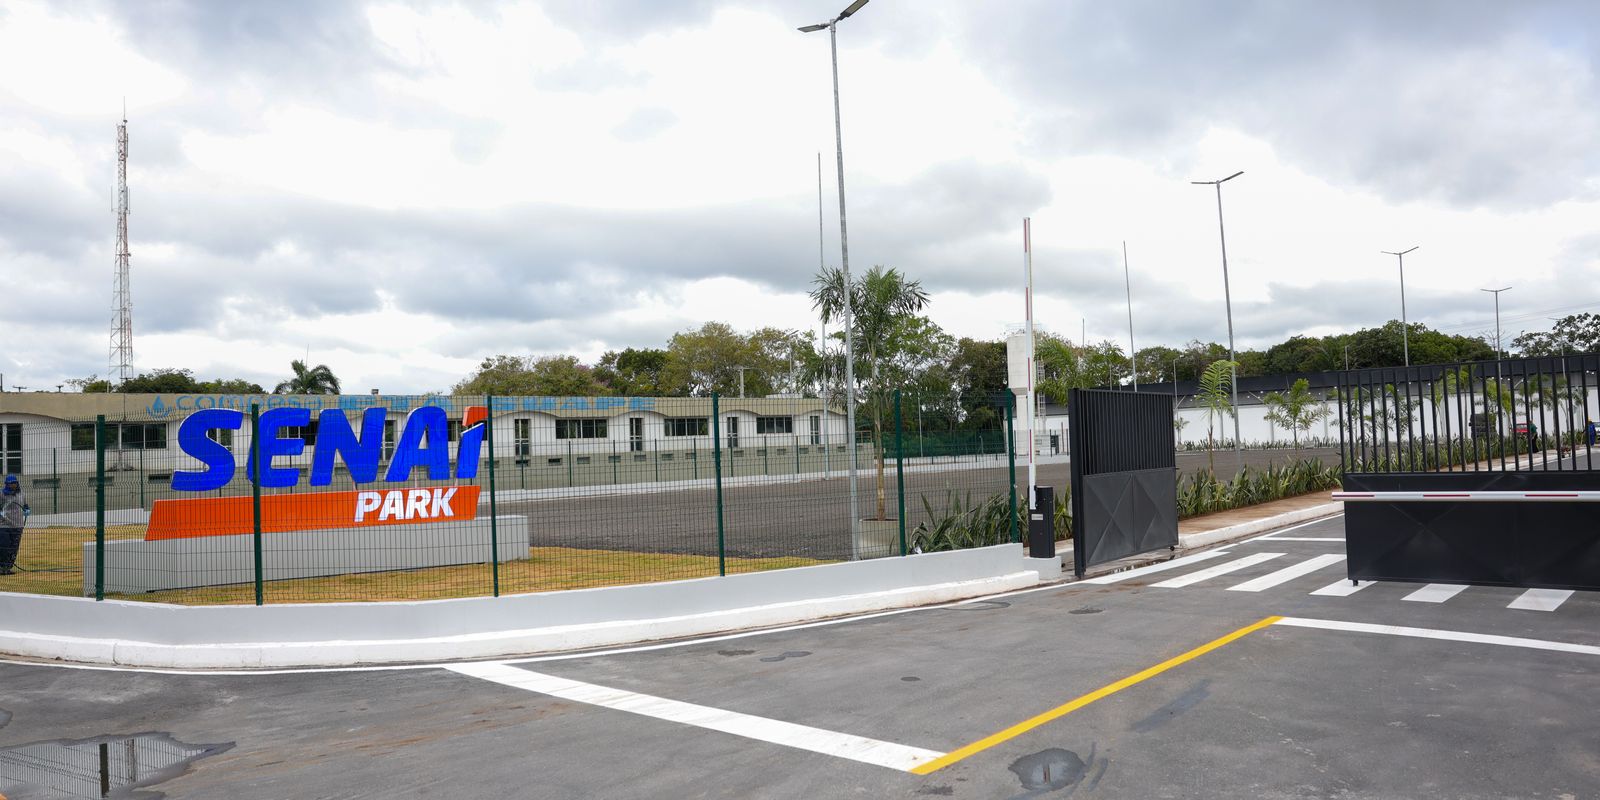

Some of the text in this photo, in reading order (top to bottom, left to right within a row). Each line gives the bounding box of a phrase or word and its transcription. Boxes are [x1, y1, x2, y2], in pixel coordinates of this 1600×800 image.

[483, 396, 656, 411] SUAPE
[171, 405, 489, 491] SENAI
[354, 488, 458, 523] PARK
